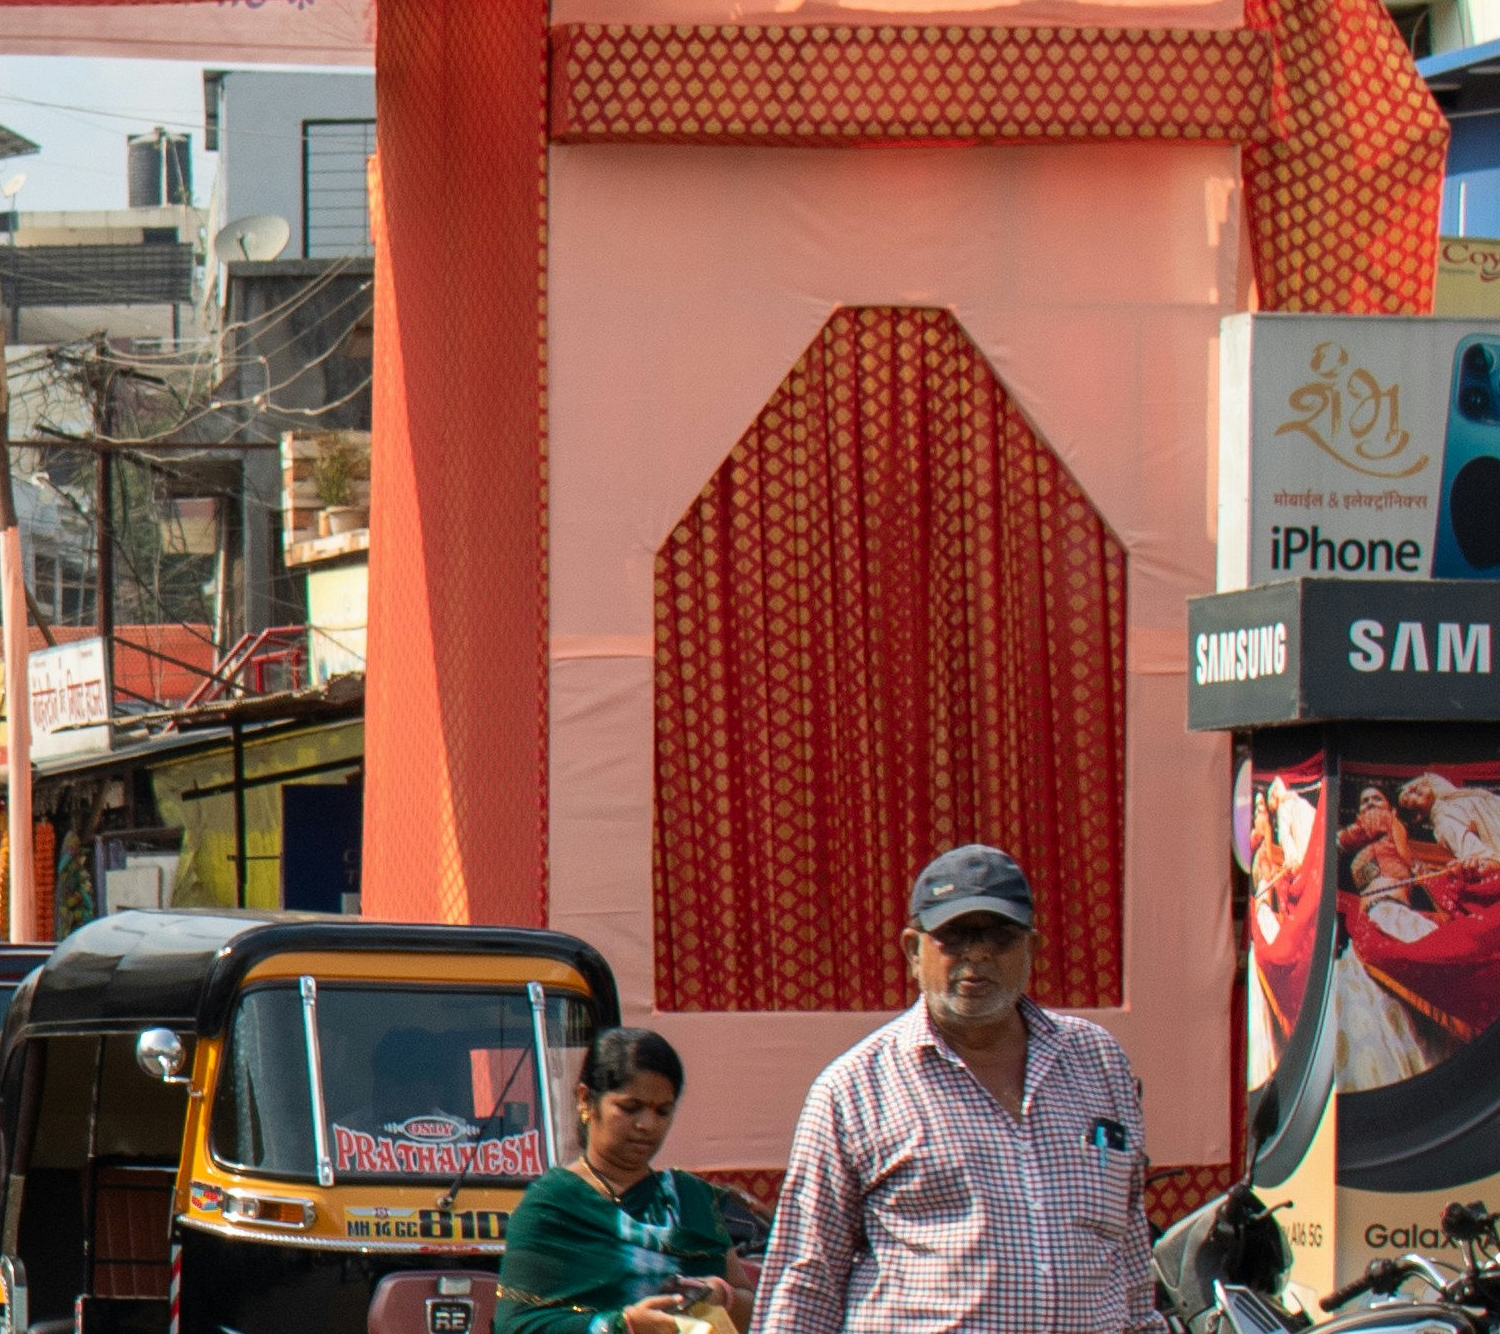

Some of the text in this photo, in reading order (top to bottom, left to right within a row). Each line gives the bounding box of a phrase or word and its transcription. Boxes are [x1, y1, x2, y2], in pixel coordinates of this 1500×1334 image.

[1273, 488, 1323, 510] मोबाईल
[1329, 491, 1339, 509] &
[1270, 525, 1421, 573] iPhone
[1195, 621, 1288, 686] SAMSUNG
[1348, 618, 1493, 674] SAM
[407, 1121, 455, 1137] ONLY
[332, 1123, 545, 1176] PRATHAMESH
[347, 1220, 370, 1237] MH
[418, 1209, 512, 1240] 810
[1290, 1222, 1307, 1247] A16
[1308, 1223, 1324, 1248] 5G
[435, 1311, 467, 1331] RE
